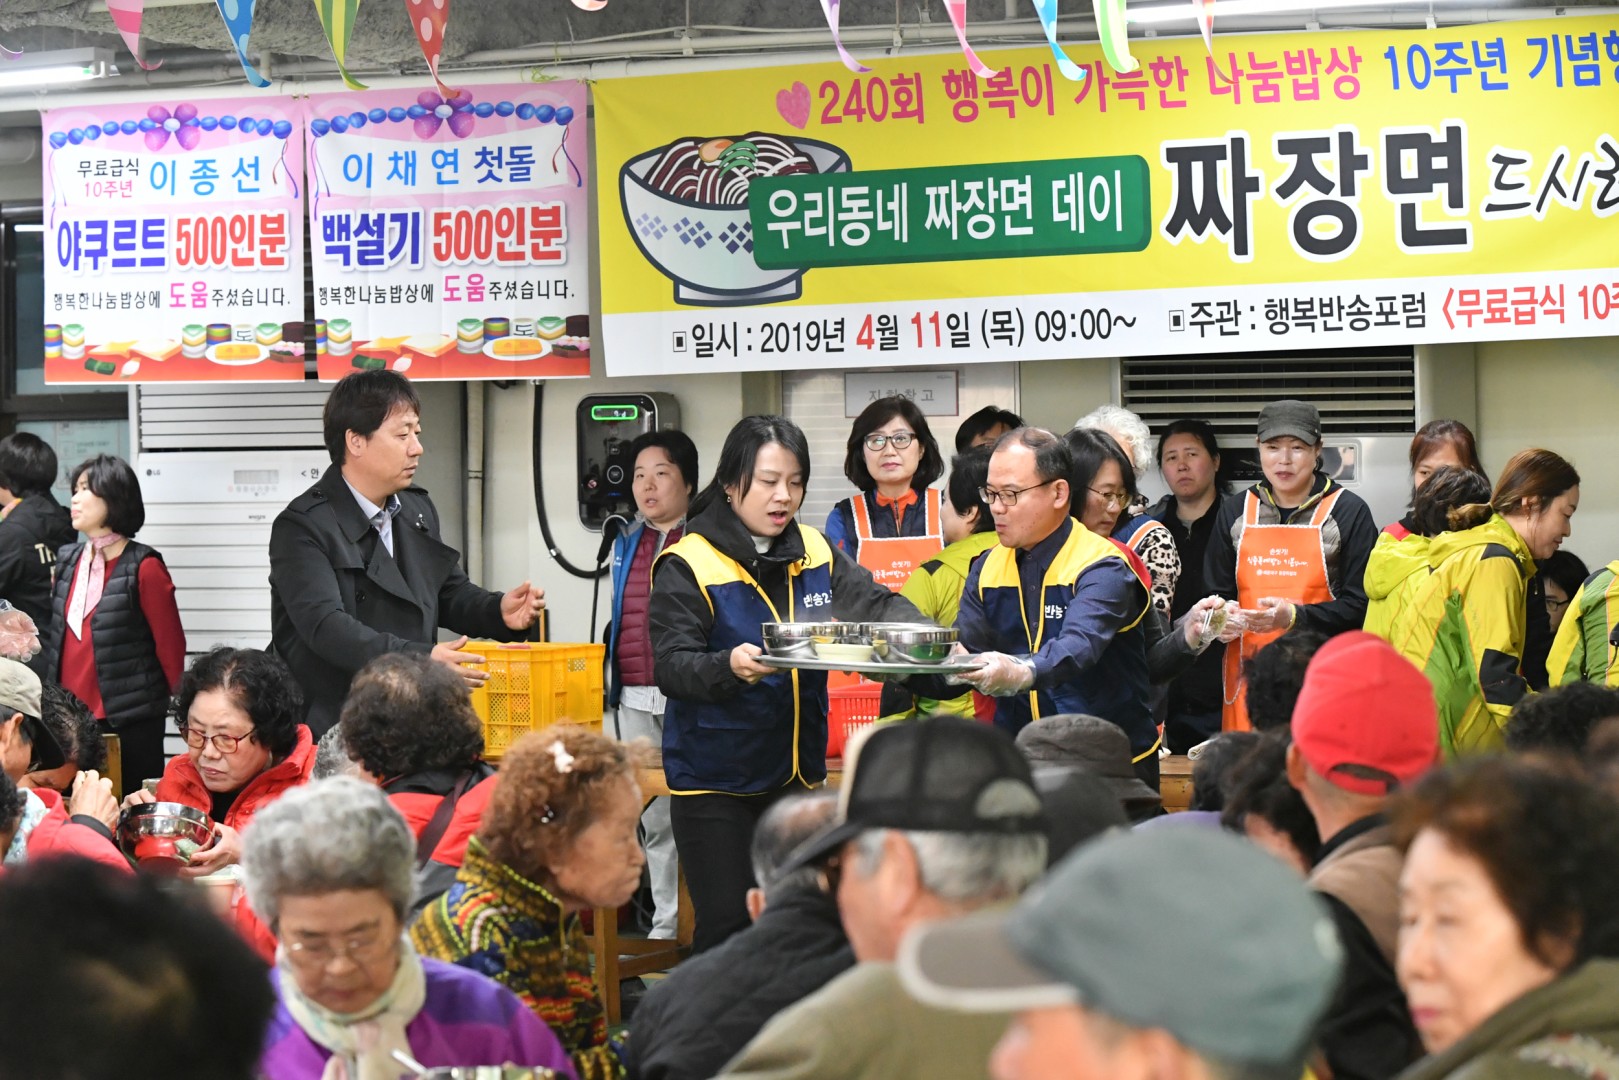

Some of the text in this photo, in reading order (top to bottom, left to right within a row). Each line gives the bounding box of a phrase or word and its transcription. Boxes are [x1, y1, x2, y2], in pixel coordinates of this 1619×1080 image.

[818, 72, 925, 125] 240회
[942, 63, 1055, 123] 행복이
[1205, 45, 1362, 105] 나눔밥상
[1383, 36, 1509, 93] 10주년
[77, 158, 139, 178] 무료급식
[84, 180, 133, 198] 10주년
[474, 145, 535, 184] 첫돌
[1165, 125, 1468, 256] 짜장면
[767, 169, 1123, 249] 우리동네 짜장면 데이
[57, 213, 285, 271] 야쿠르트 500인분
[322, 205, 563, 266] 백설기 500인분
[760, 317, 845, 353] 2019년
[856, 313, 899, 351] 4월
[911, 311, 970, 349] 11일
[981, 307, 1024, 349] (목)
[1035, 308, 1137, 342] 09:00~
[1264, 291, 1426, 336] 행복반송포럼
